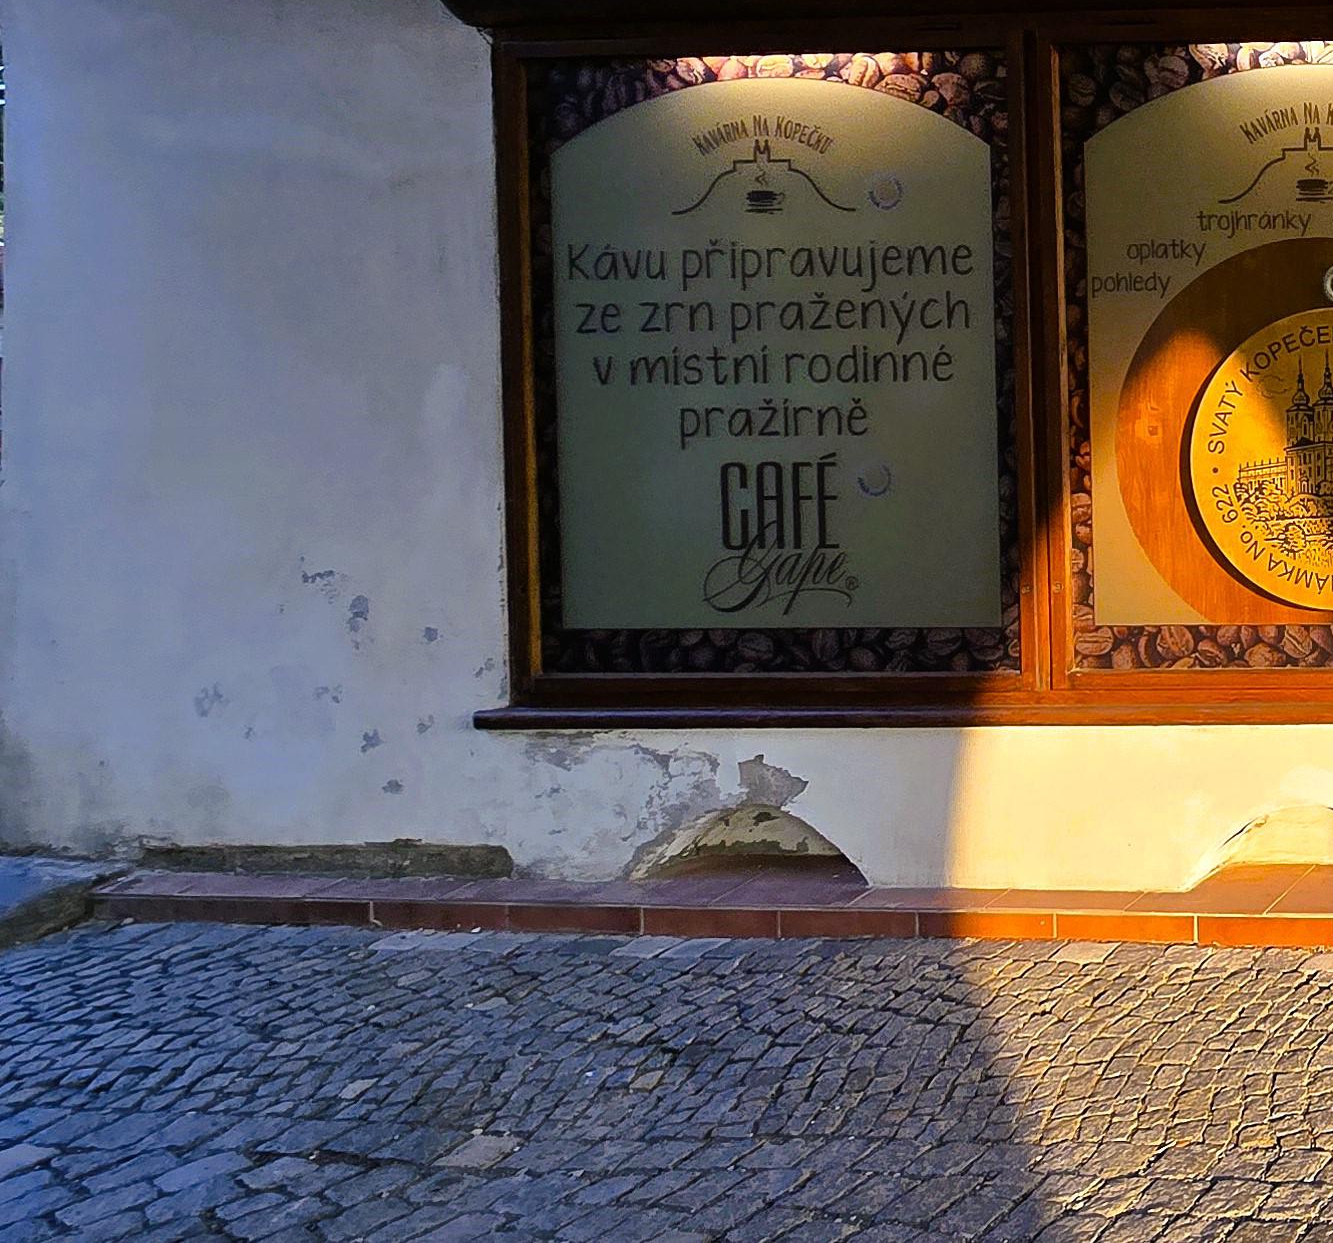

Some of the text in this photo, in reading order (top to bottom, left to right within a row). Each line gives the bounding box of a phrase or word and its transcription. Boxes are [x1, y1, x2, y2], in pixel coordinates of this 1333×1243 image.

[692, 115, 833, 156] KAVÁRNA NA KOPEČKU
[1240, 107, 1298, 144] KAVÁRNA
[1303, 102, 1320, 125] NA
[1197, 210, 1311, 238] trojhránky
[567, 238, 974, 292] Kávu připravujeme
[1127, 238, 1207, 266] oplatky
[1091, 271, 1171, 298] pohledy
[576, 291, 970, 345] ze zrn pražených
[593, 344, 954, 385] v místní rodinné
[679, 398, 870, 449] pražírně
[1208, 380, 1244, 454] SVATÝ
[720, 452, 840, 551] CAFÉ
[1211, 483, 1239, 524] 622
